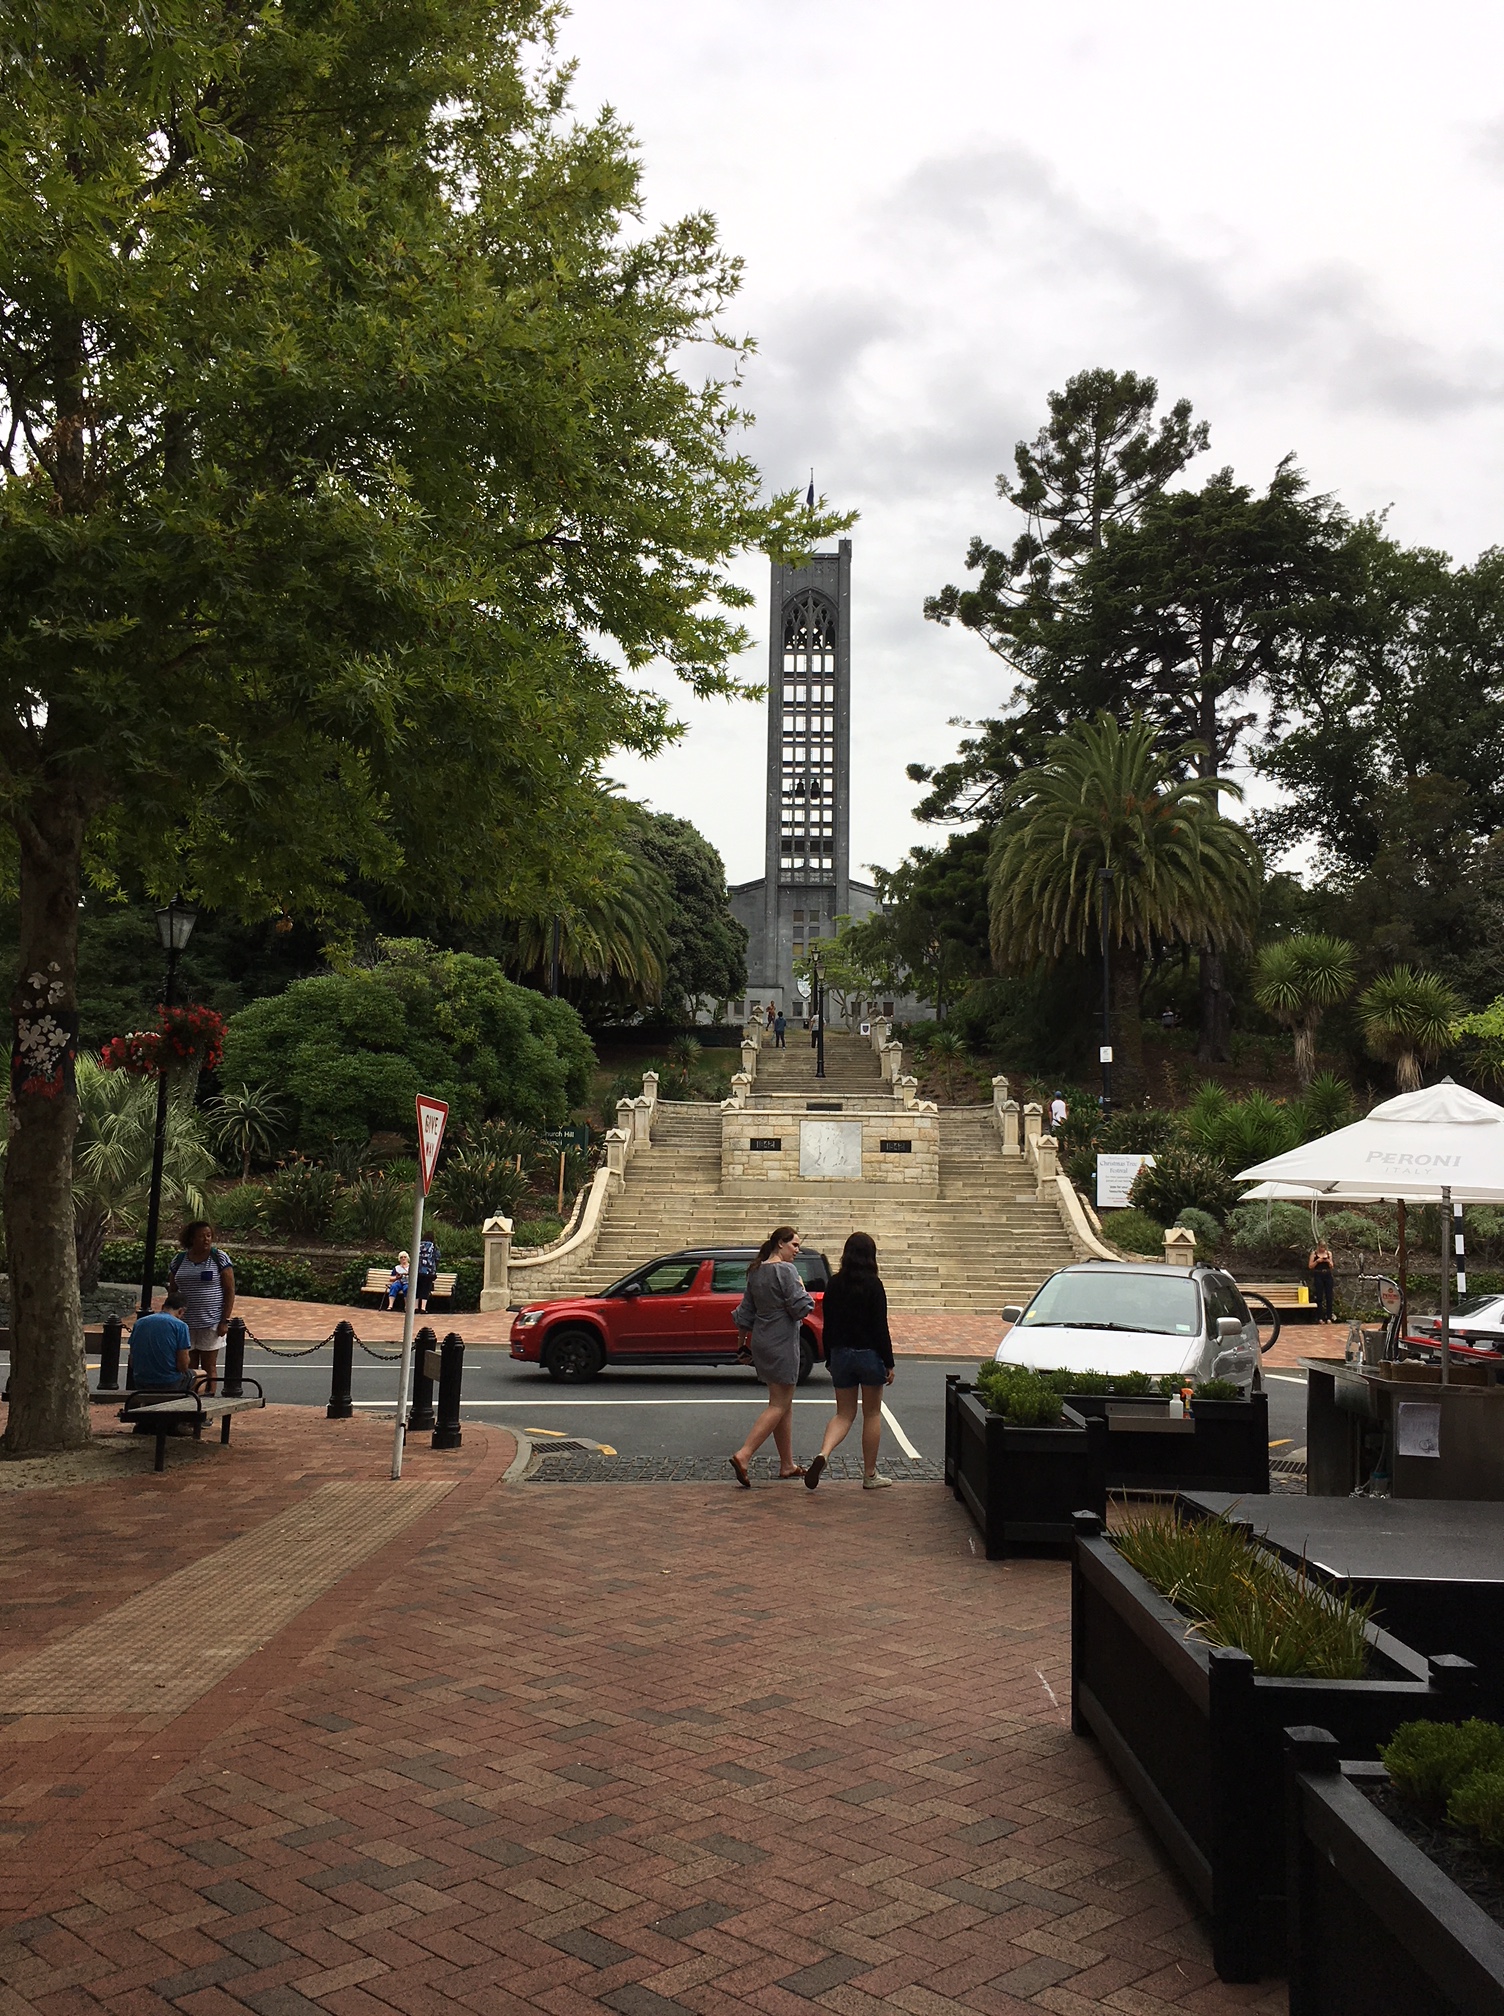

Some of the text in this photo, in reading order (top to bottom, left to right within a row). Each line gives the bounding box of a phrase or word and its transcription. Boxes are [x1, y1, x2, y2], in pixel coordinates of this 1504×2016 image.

[425, 1114, 438, 1135] GIVE
[426, 1142, 435, 1157] WAY
[1365, 1151, 1462, 1167] PERONI
[1385, 1167, 1432, 1175] ITALY
